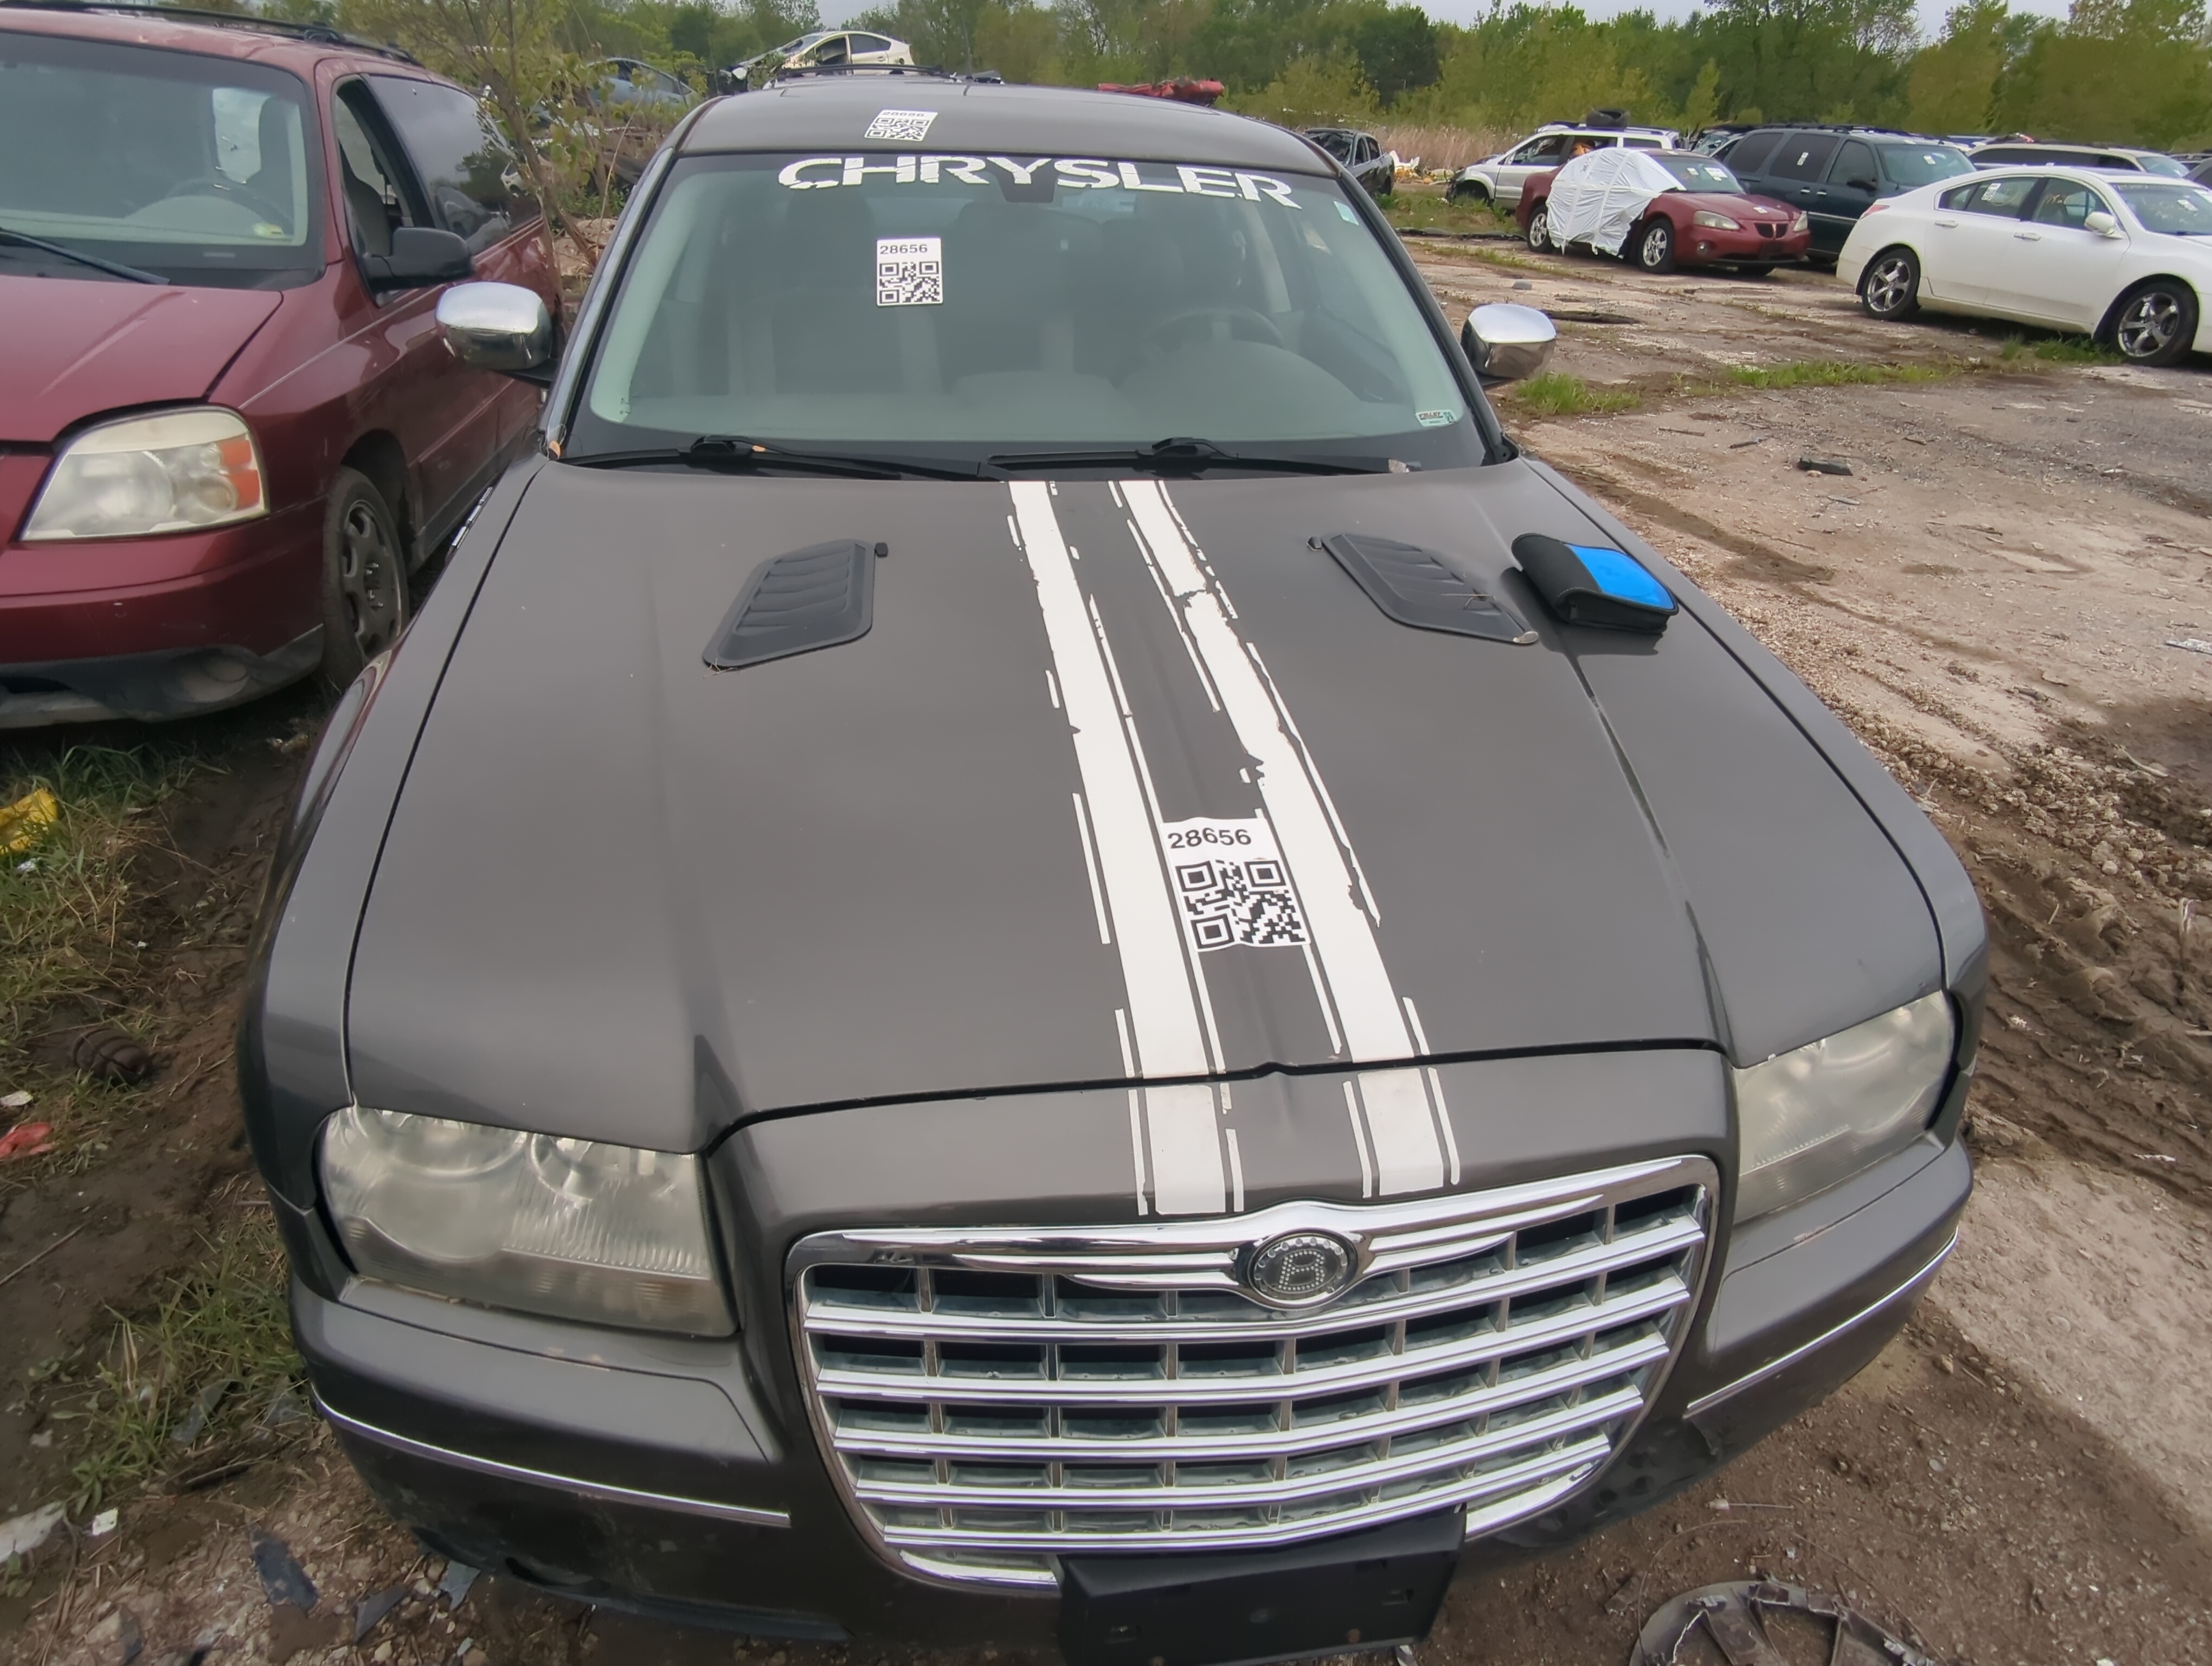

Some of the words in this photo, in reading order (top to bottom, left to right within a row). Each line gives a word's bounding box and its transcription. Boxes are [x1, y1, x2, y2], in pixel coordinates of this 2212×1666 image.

[778, 156, 1302, 209] CHRYSLER
[879, 244, 928, 254] 28656
[1167, 828, 1252, 849] 28656
